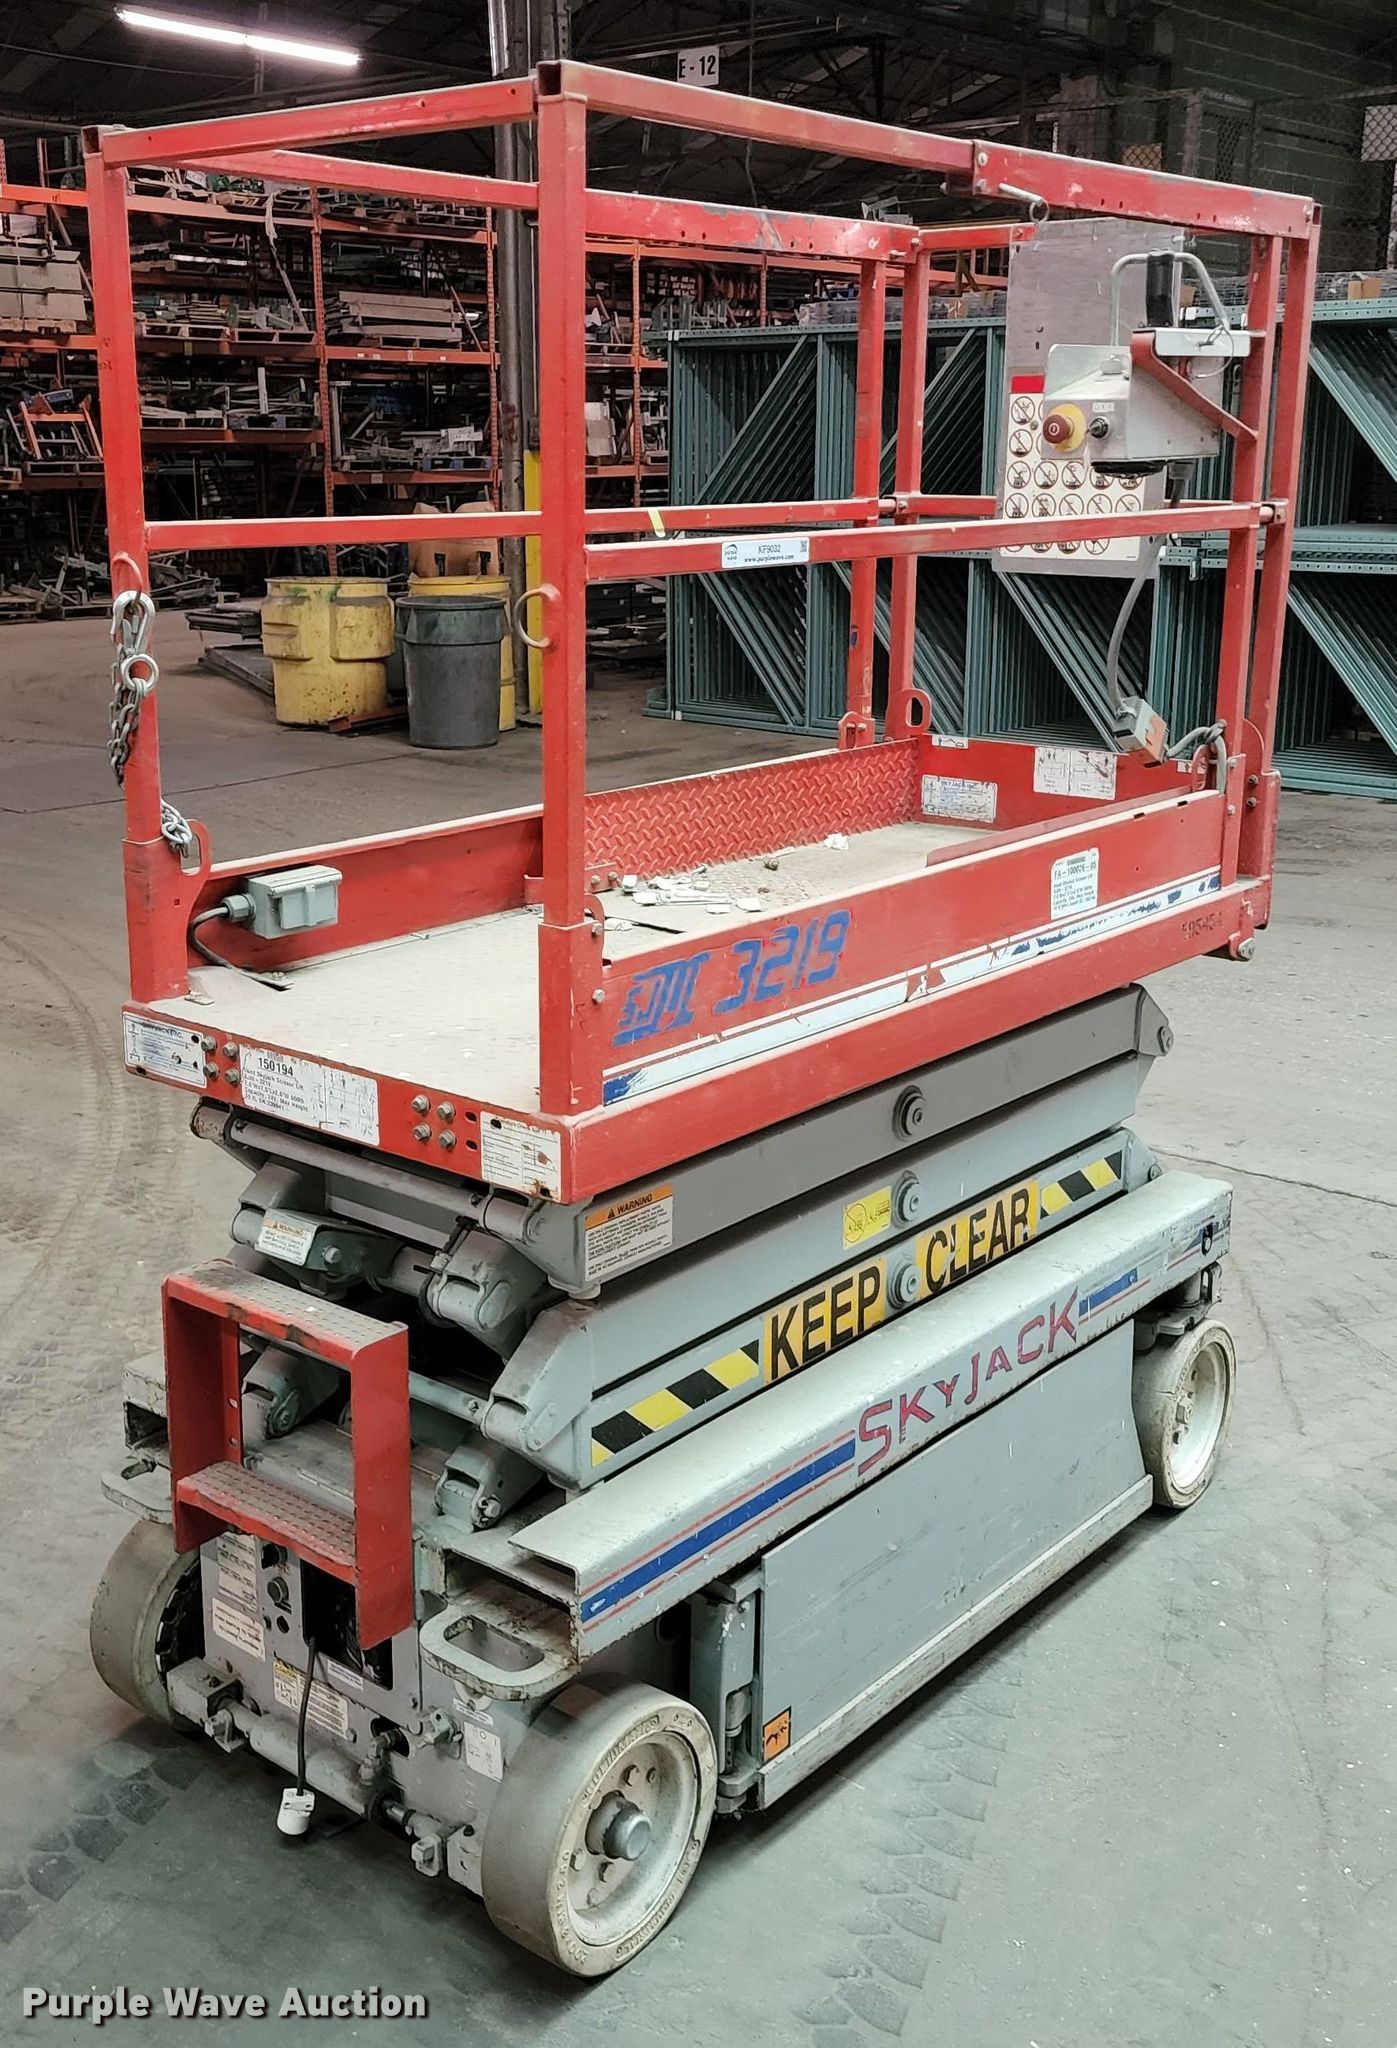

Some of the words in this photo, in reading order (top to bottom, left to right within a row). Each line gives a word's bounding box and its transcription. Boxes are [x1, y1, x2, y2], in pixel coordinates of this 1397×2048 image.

[713, 909, 851, 1015] 3219
[258, 1058, 294, 1076] 150194
[617, 1193, 653, 1215] WARNING
[770, 1265, 881, 1380] KEEP
[925, 1187, 1030, 1293] CLEAR
